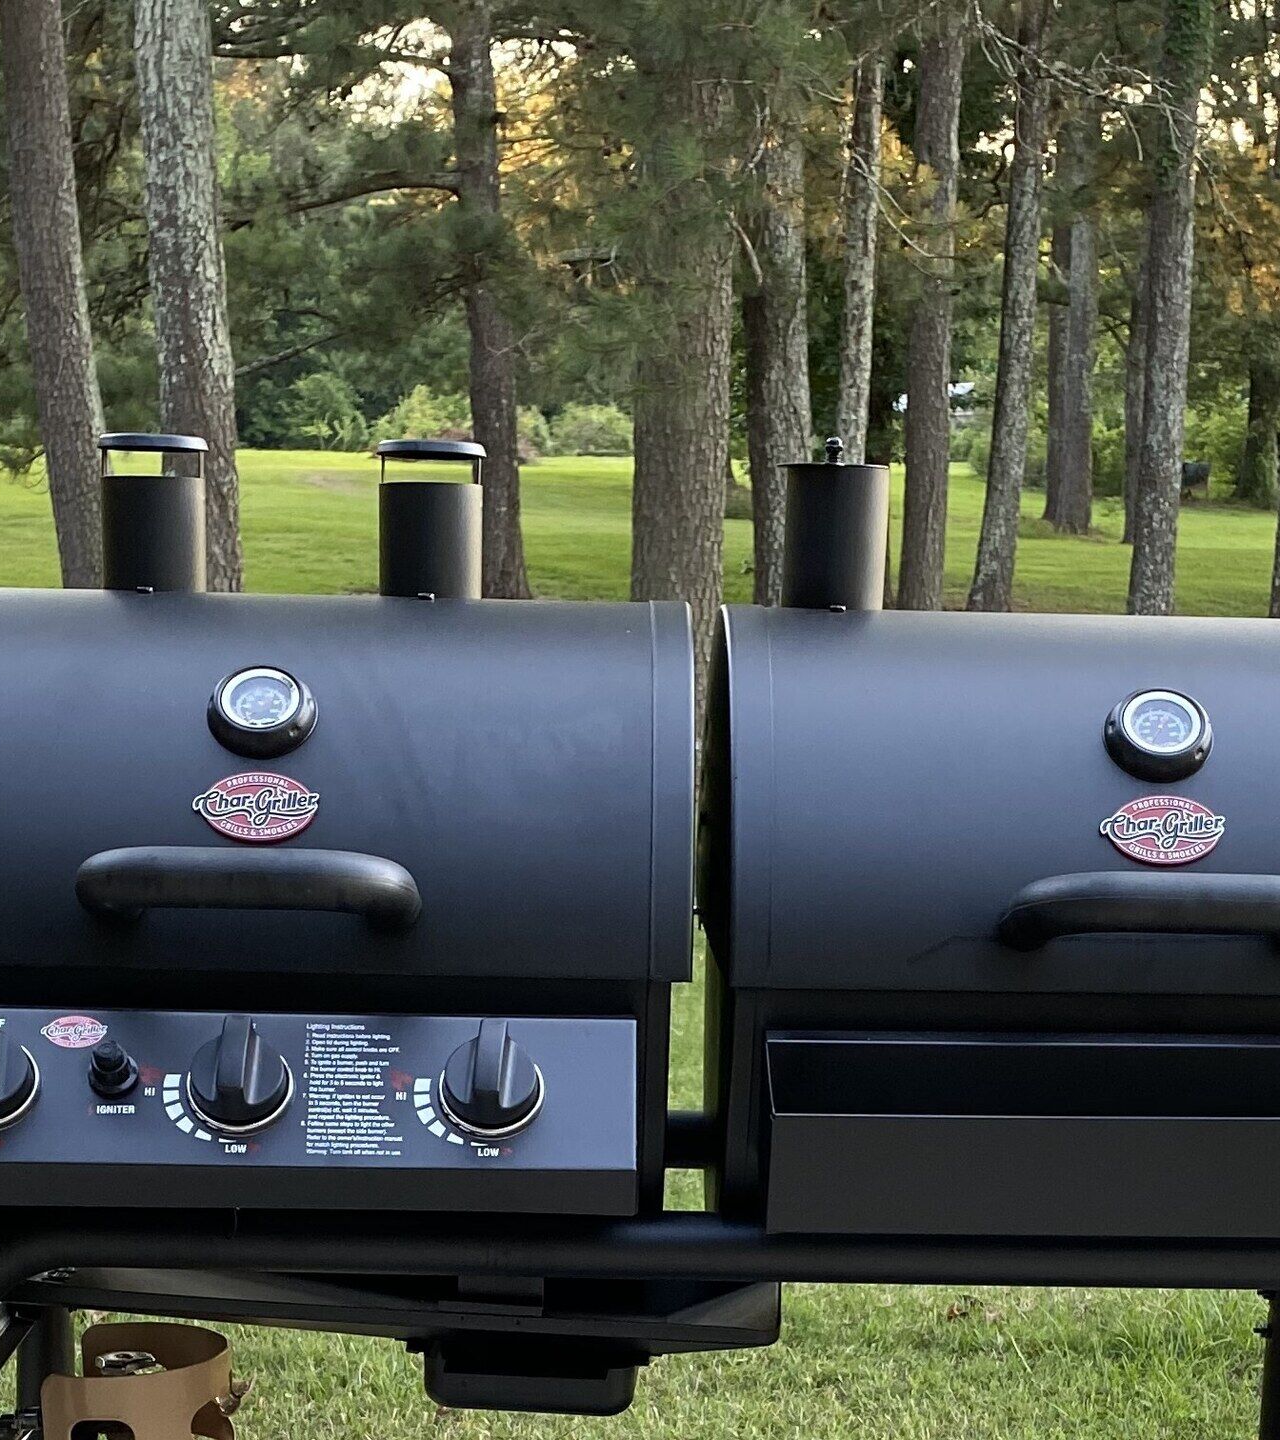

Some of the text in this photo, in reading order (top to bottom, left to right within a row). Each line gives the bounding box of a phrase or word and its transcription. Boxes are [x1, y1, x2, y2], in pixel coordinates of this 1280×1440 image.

[226, 775, 289, 788] PROFESSIONAL
[192, 786, 320, 828] Char-Griller
[1131, 798, 1194, 811] PROFESSIONAL
[220, 820, 299, 836] GRILLS & SMOKERS
[1099, 808, 1226, 852] Char-Griller
[1127, 842, 1158, 859] GRILLS
[1167, 844, 1206, 860] SMOKERS
[40, 1023, 108, 1043] Char-Griller
[144, 1087, 156, 1097] HI
[395, 1092, 407, 1101] HI
[96, 1105, 135, 1114] IGNITER
[224, 1144, 247, 1154] LOW
[477, 1148, 500, 1157] LOW
